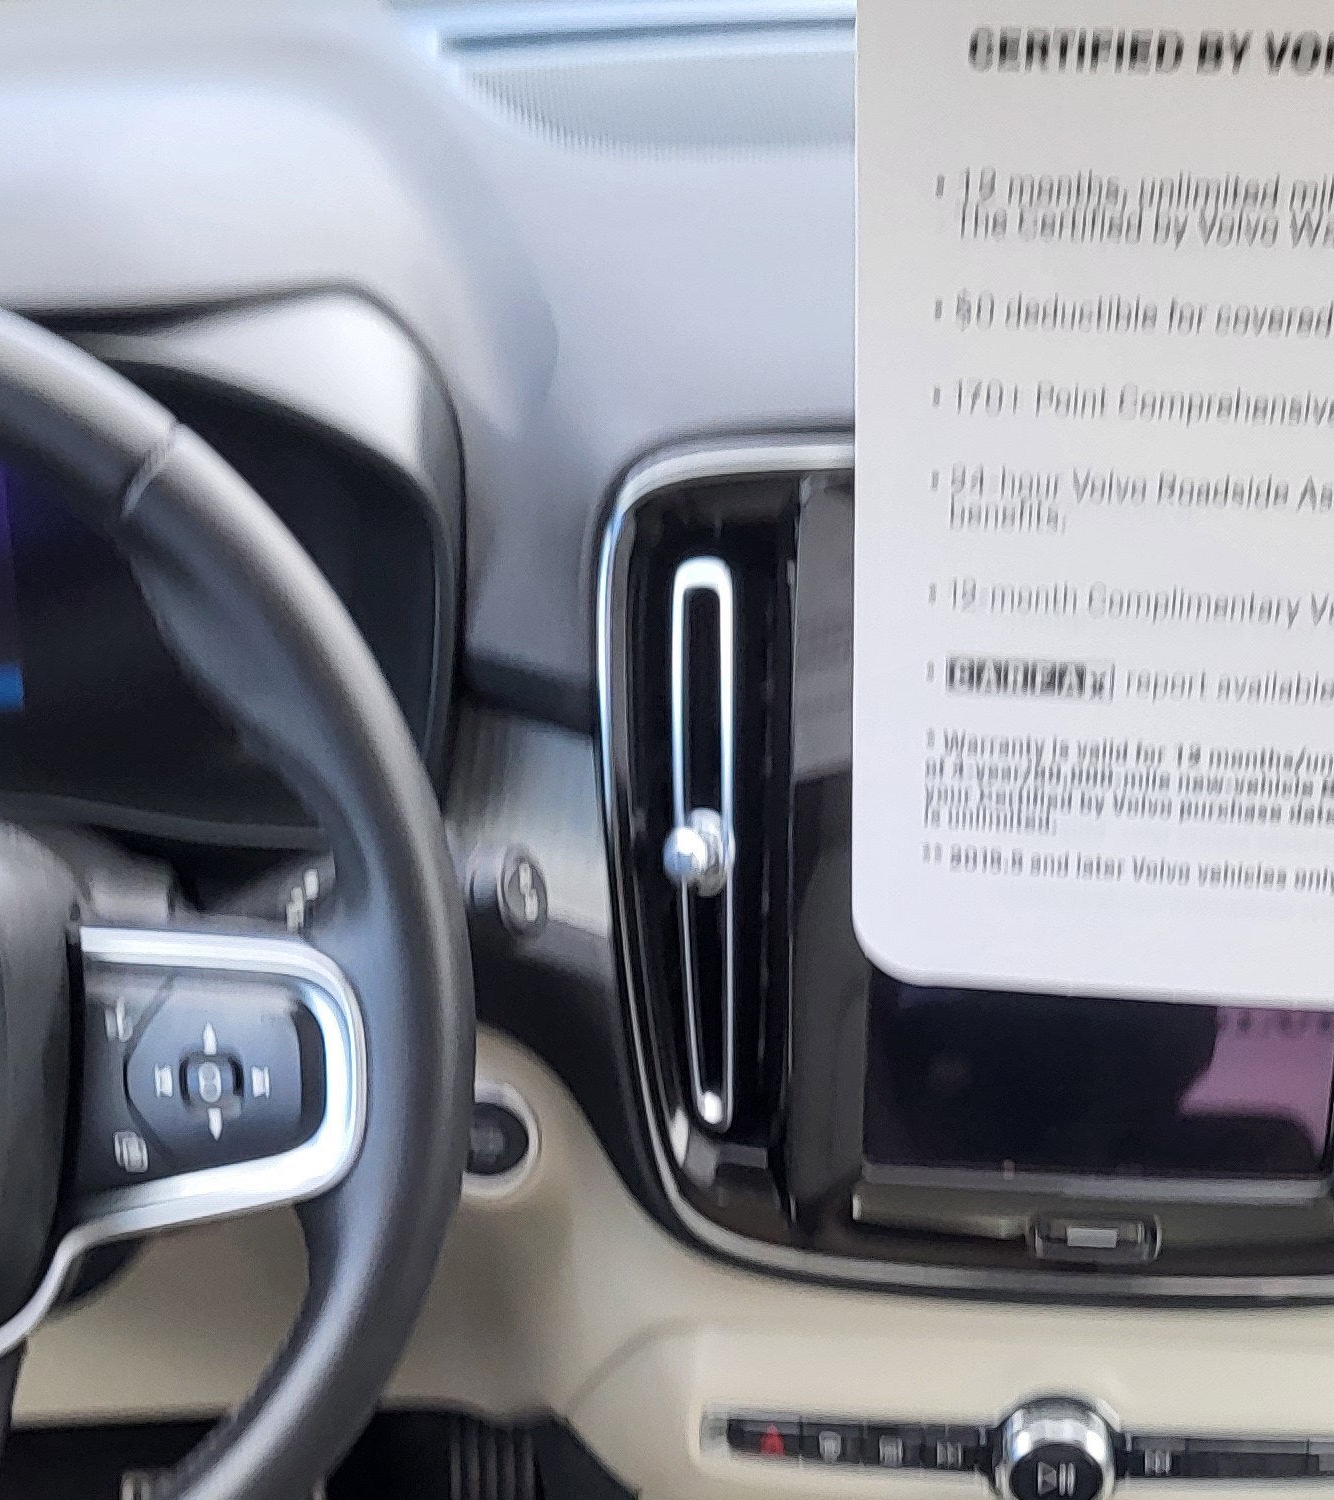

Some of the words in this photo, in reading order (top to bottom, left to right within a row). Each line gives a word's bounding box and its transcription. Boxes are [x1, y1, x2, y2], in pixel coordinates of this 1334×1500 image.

[968, 26, 1185, 73] CERTIFIED
[1197, 28, 1253, 75] BY
[1140, 171, 1280, 209] unlimited
[960, 202, 1007, 242] The
[1017, 205, 1144, 244] Certified
[1153, 206, 1188, 250] by
[1198, 208, 1279, 248] Volvo
[955, 290, 995, 332] $0
[1004, 290, 1158, 333] deductible
[1168, 296, 1207, 335] for
[1214, 300, 1334, 338] covered
[1036, 380, 1107, 420] Point
[1071, 466, 1147, 505] Volvo
[1157, 470, 1290, 510] Roadside
[1088, 581, 1300, 630] Complimentary
[945, 652, 1116, 704] CARFAX
[1126, 668, 1206, 704] report
